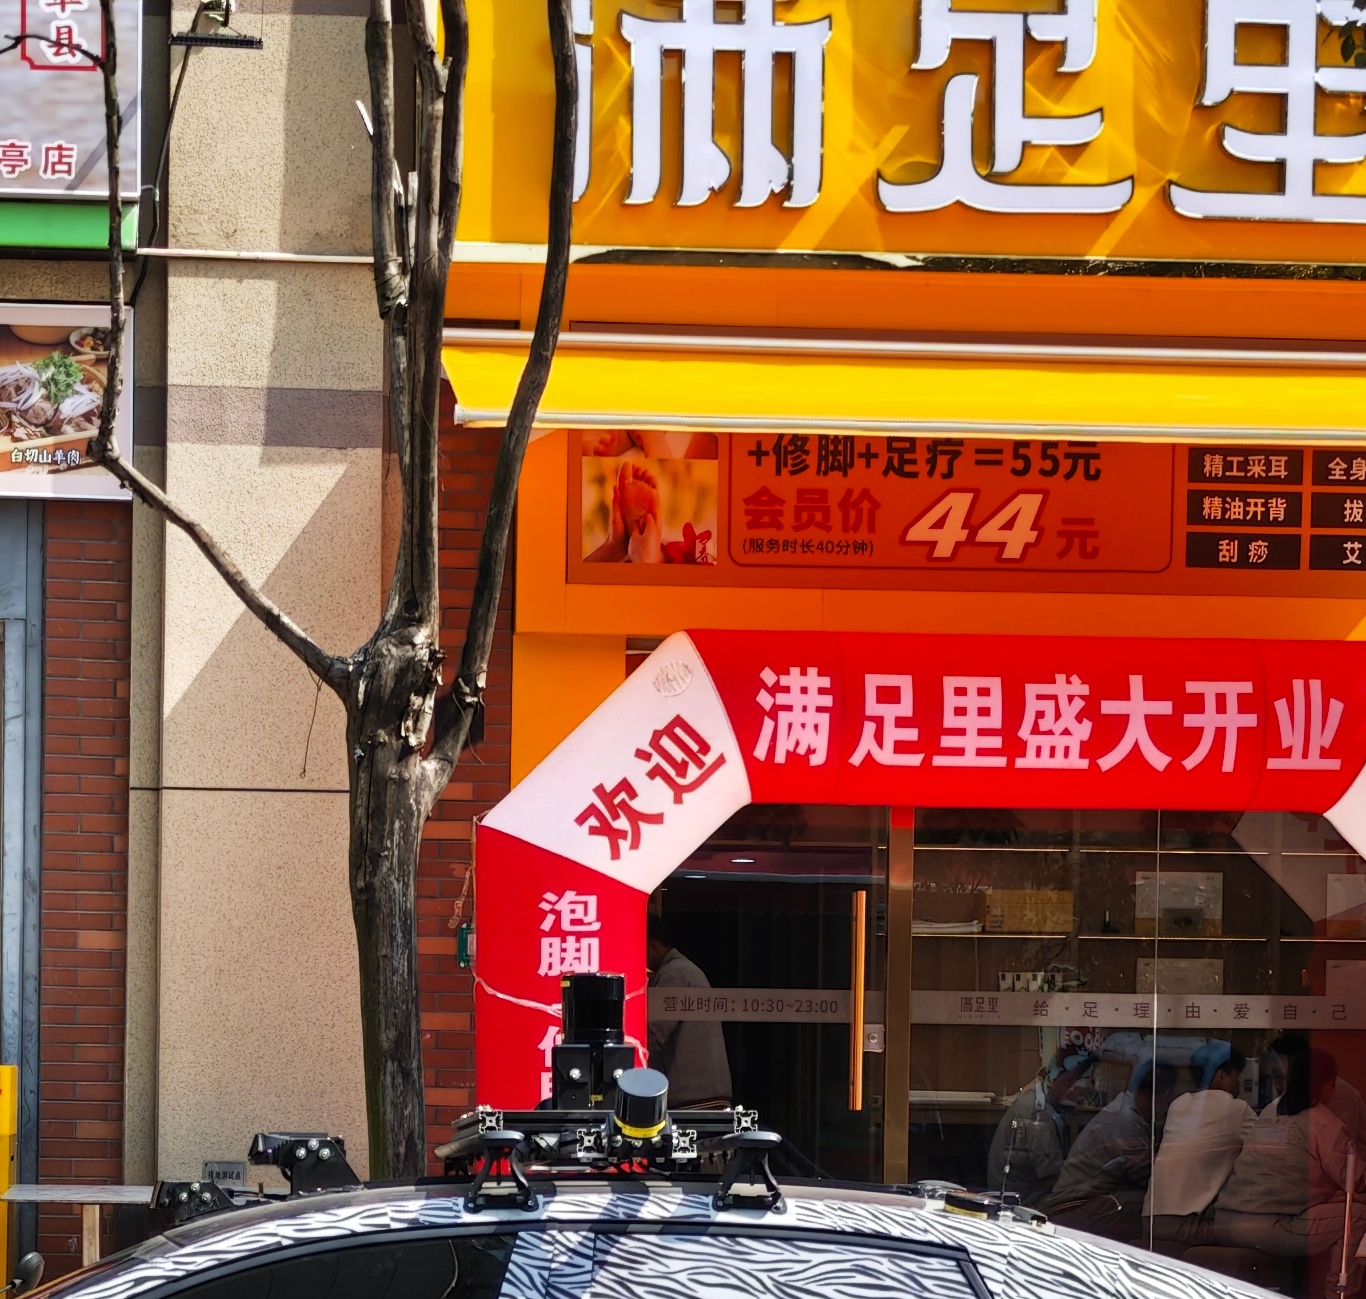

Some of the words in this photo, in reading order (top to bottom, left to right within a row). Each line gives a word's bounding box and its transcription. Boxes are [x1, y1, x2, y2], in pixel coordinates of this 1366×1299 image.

[11, 448, 80, 465] 白切山羊肉
[1204, 454, 1288, 479] 精工采耳
[1203, 496, 1286, 522] 精油开背
[743, 486, 881, 533] 会员价
[901, 489, 1048, 561] 44
[1056, 517, 1100, 559] 元
[742, 538, 874, 555] (服务时长40分钟)
[756, 666, 1344, 773] 满足里盛大开业
[575, 713, 726, 862] 欢迎
